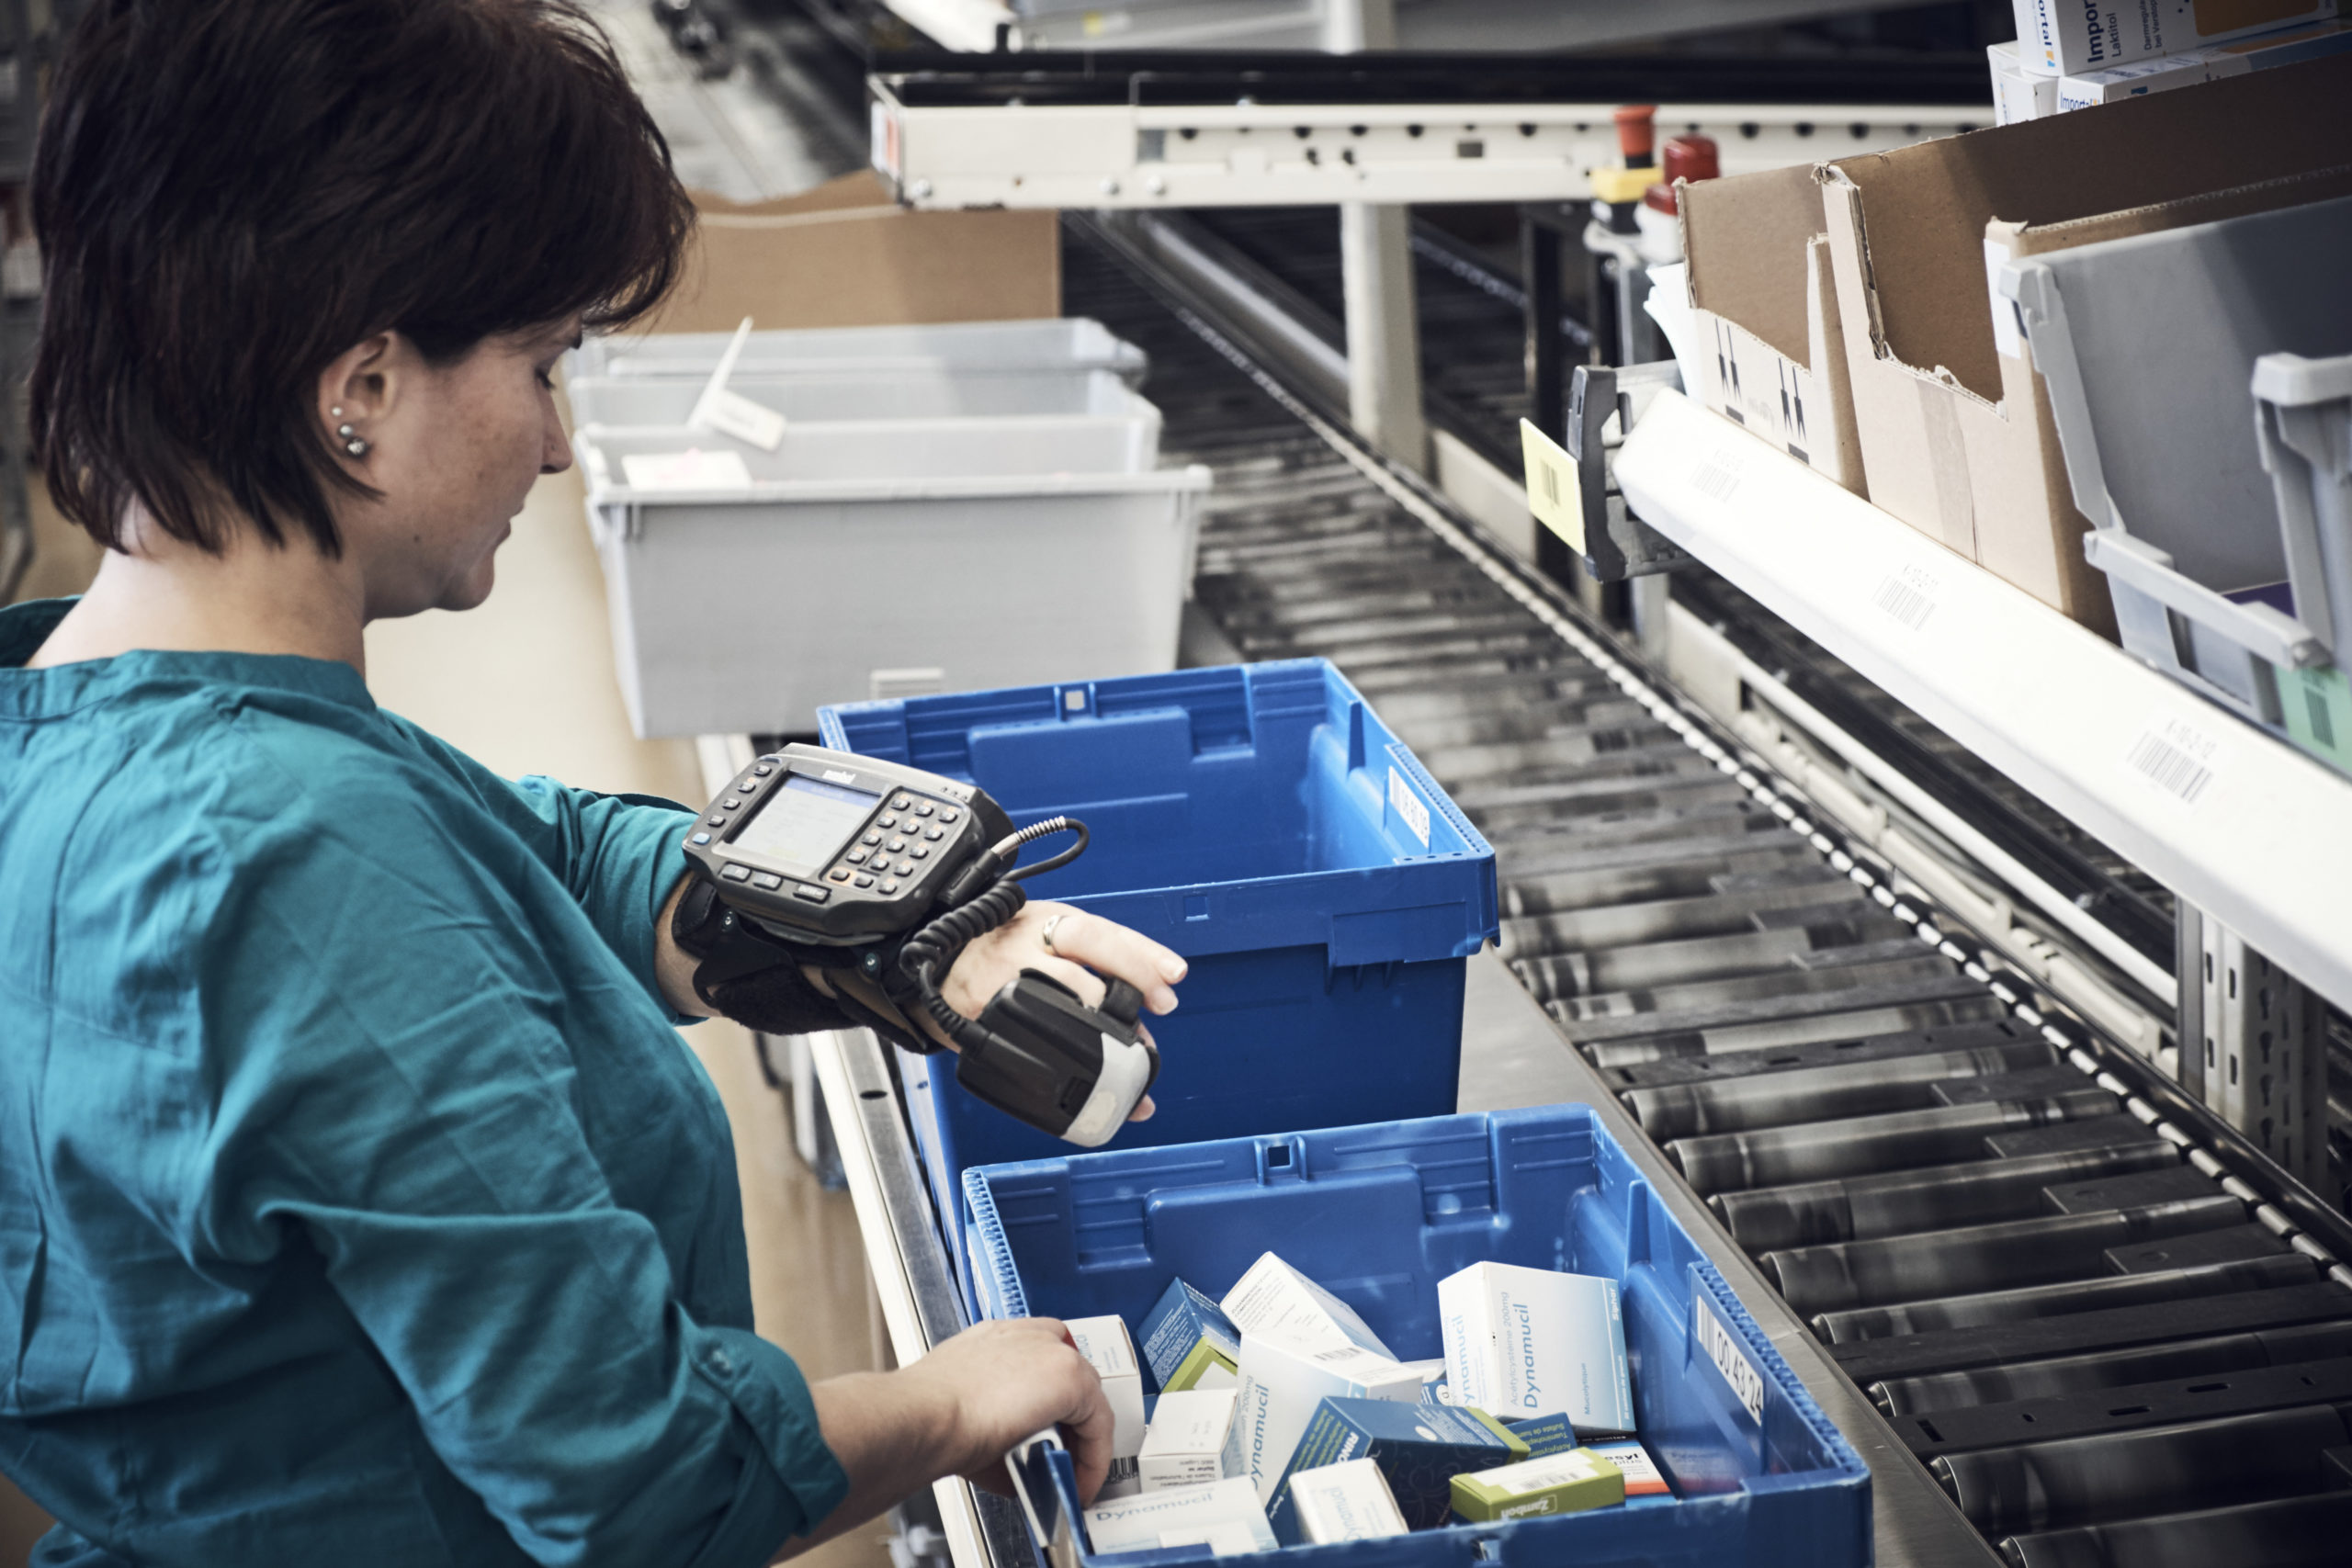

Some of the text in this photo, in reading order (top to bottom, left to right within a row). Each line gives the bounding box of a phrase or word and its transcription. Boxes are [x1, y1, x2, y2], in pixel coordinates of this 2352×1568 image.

[2039, 0, 2052, 46] ortal
[2084, 0, 2104, 62] Impor
[2106, 12, 2121, 58] Laktitol
[2139, 0, 2153, 51] Darmregula
[2150, 0, 2161, 34] Verstop
[1452, 1314, 1476, 1404] ynamucil
[1512, 1303, 1541, 1408] Dynamucil
[1718, 1331, 1762, 1420] 00 43 24
[1337, 1431, 1360, 1464] RINO
[1096, 1493, 1213, 1521] Dynamucil
